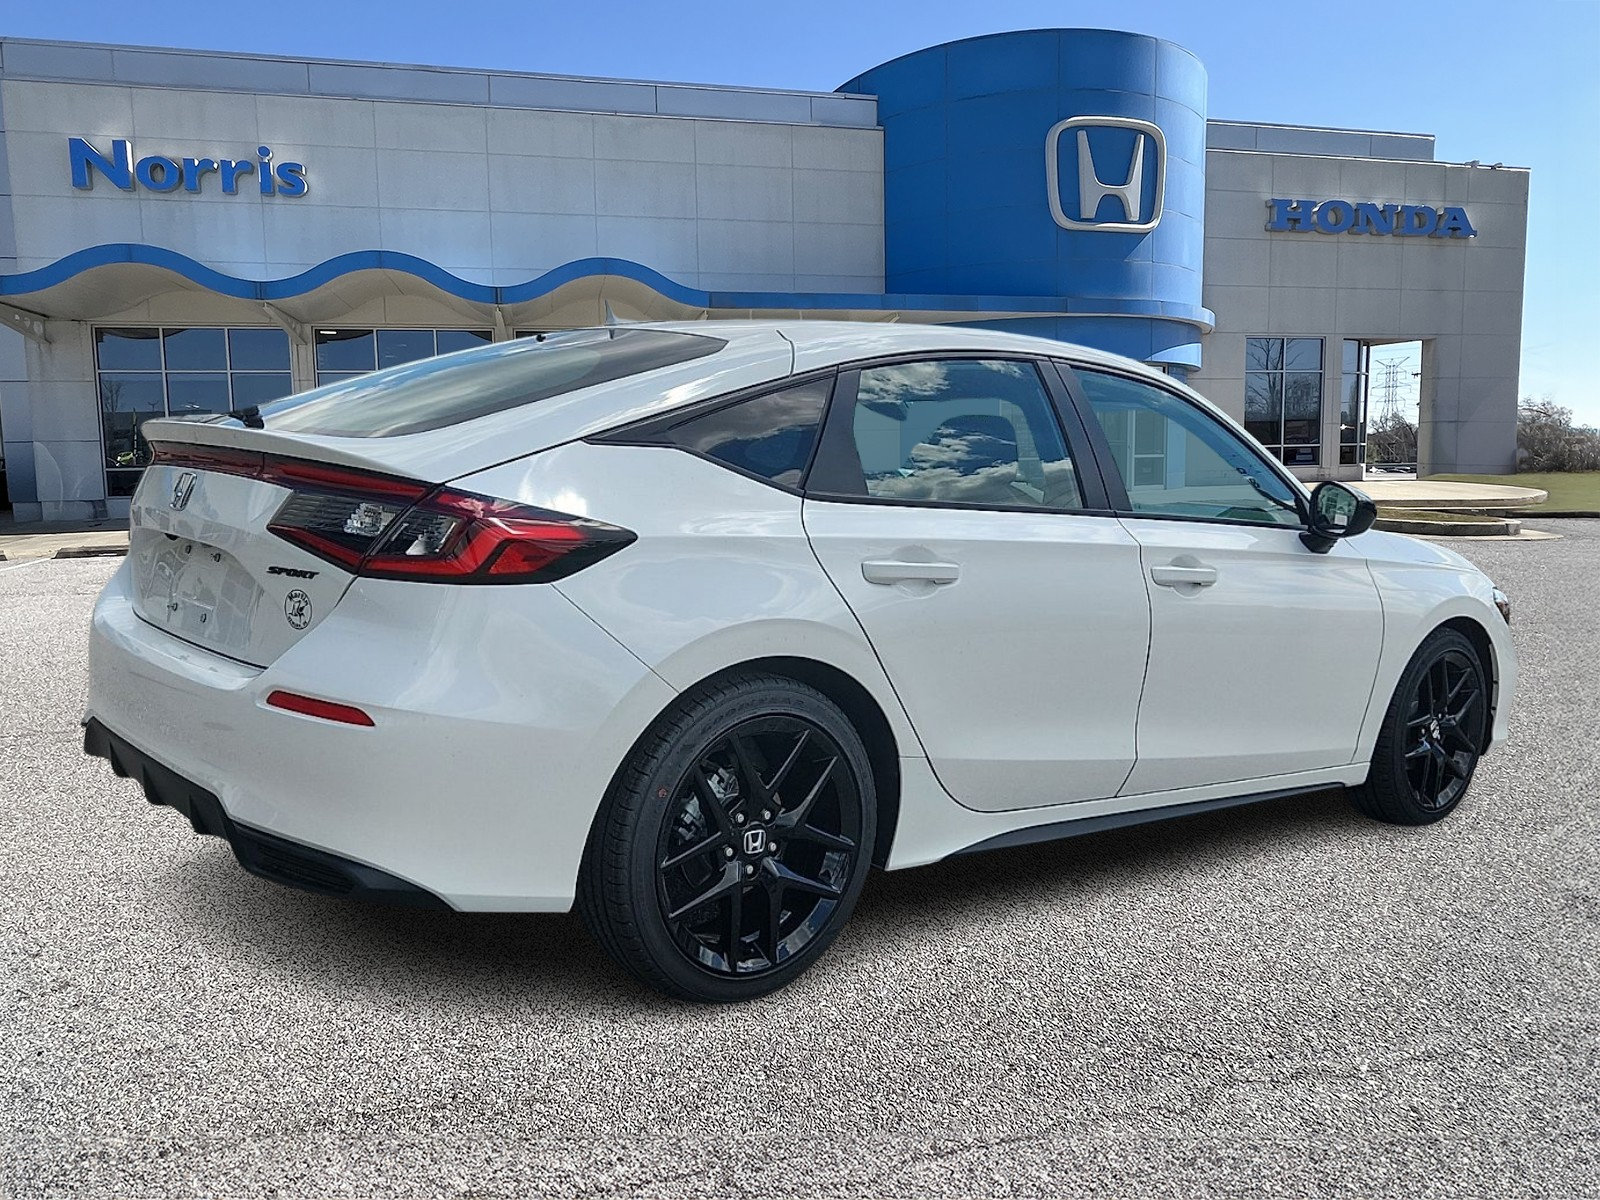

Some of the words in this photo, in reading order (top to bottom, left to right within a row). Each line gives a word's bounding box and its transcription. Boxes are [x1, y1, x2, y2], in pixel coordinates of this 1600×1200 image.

[68, 137, 309, 197] Norris
[1266, 199, 1478, 239] HONDA
[266, 566, 320, 579] SPORT
